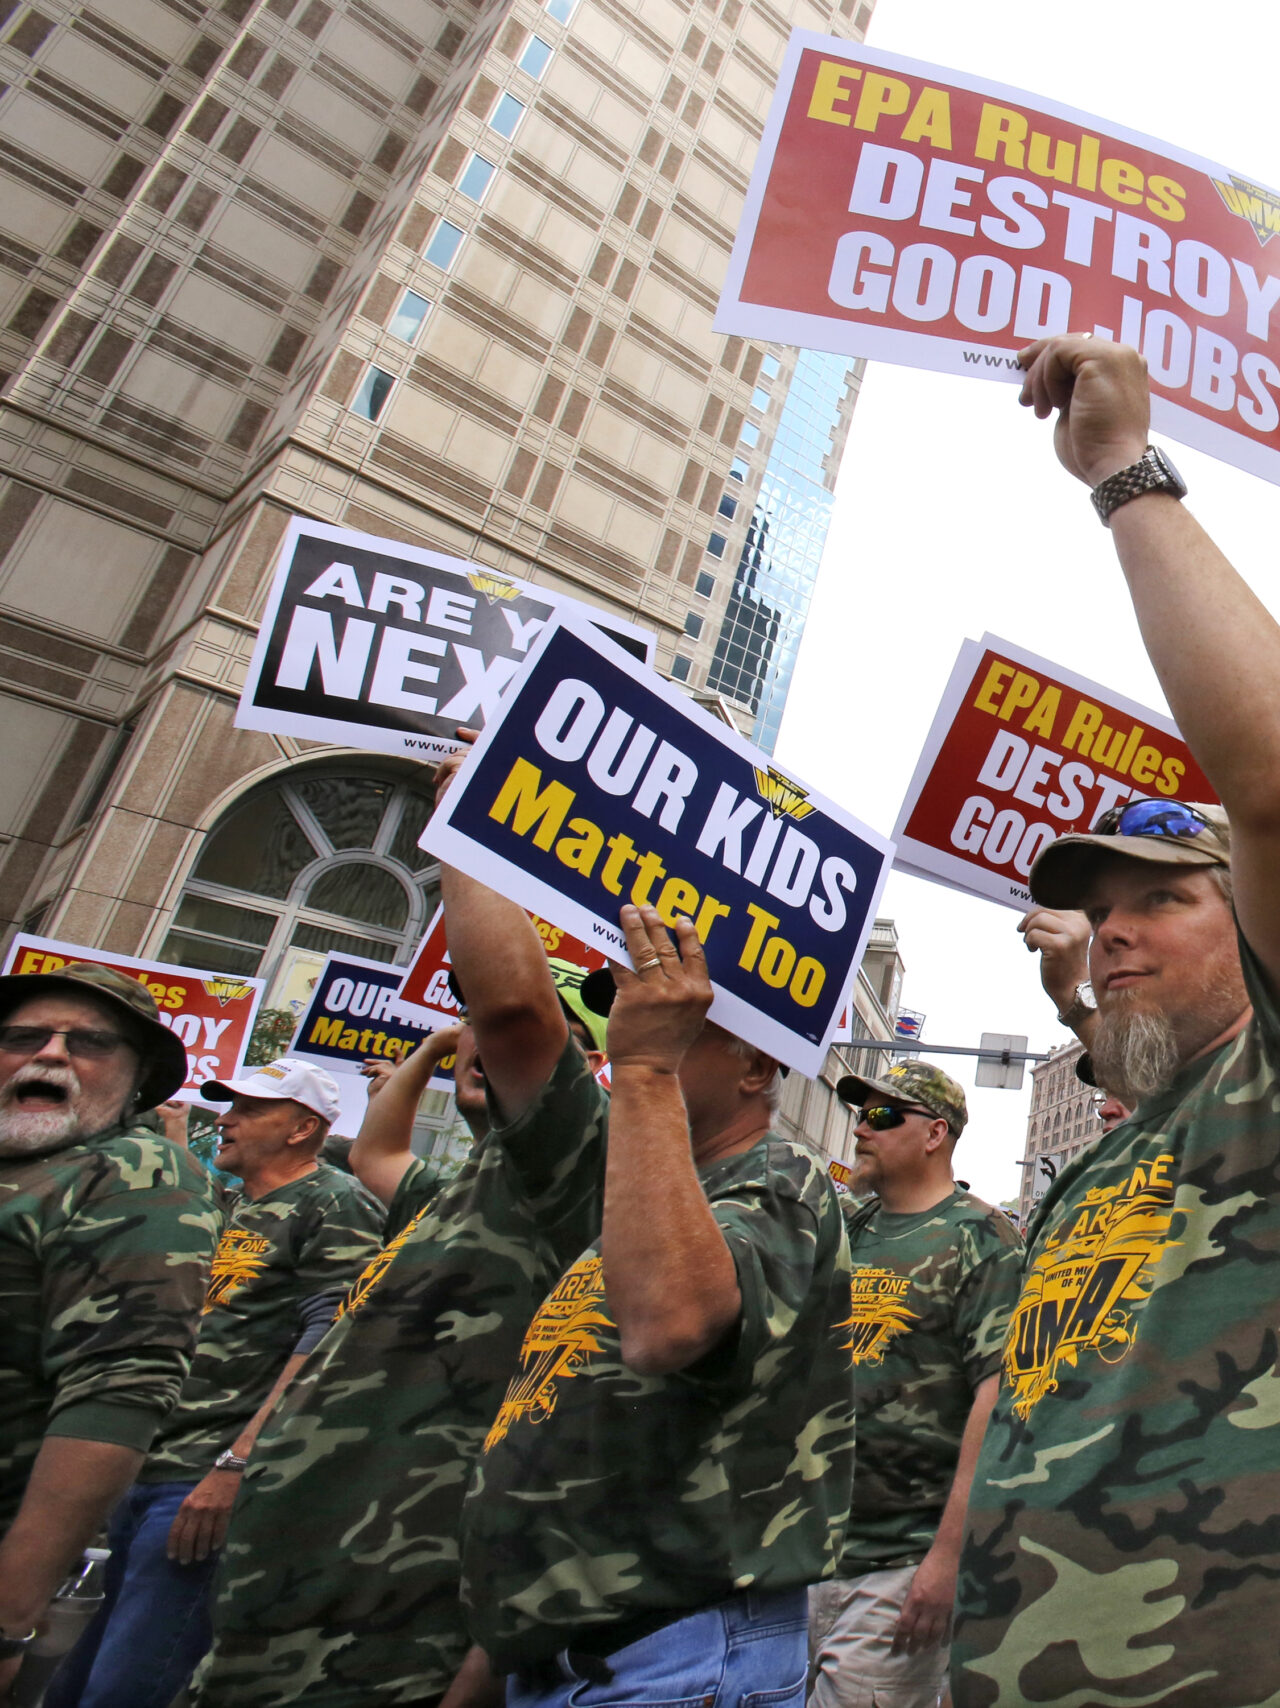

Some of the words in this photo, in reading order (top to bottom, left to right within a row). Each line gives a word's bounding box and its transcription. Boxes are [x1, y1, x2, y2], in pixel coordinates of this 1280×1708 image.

[806, 59, 953, 151] EPA
[974, 102, 1187, 223] Rules
[827, 230, 1073, 341] GOOD
[303, 561, 477, 636] ARE
[274, 603, 524, 723] NEX
[973, 660, 1063, 740] EPA
[1061, 699, 1186, 796] Rules
[534, 678, 699, 836] OUR
[695, 780, 858, 933] KIDS
[755, 766, 815, 819] UMWA
[976, 728, 1147, 832] DEST
[950, 794, 1058, 878] GOO
[488, 756, 731, 946] Matter
[737, 901, 827, 1008] Too
[18, 951, 80, 975] EP
[324, 977, 399, 1021] OUR
[308, 1016, 415, 1059] Matter
[238, 1239, 270, 1253] ONE
[1044, 1267, 1073, 1283] UNITED
[551, 1277, 590, 1301] ARE
[851, 1277, 878, 1294] ARE
[878, 1278, 911, 1296] ONE
[1061, 1277, 1074, 1288] OF
